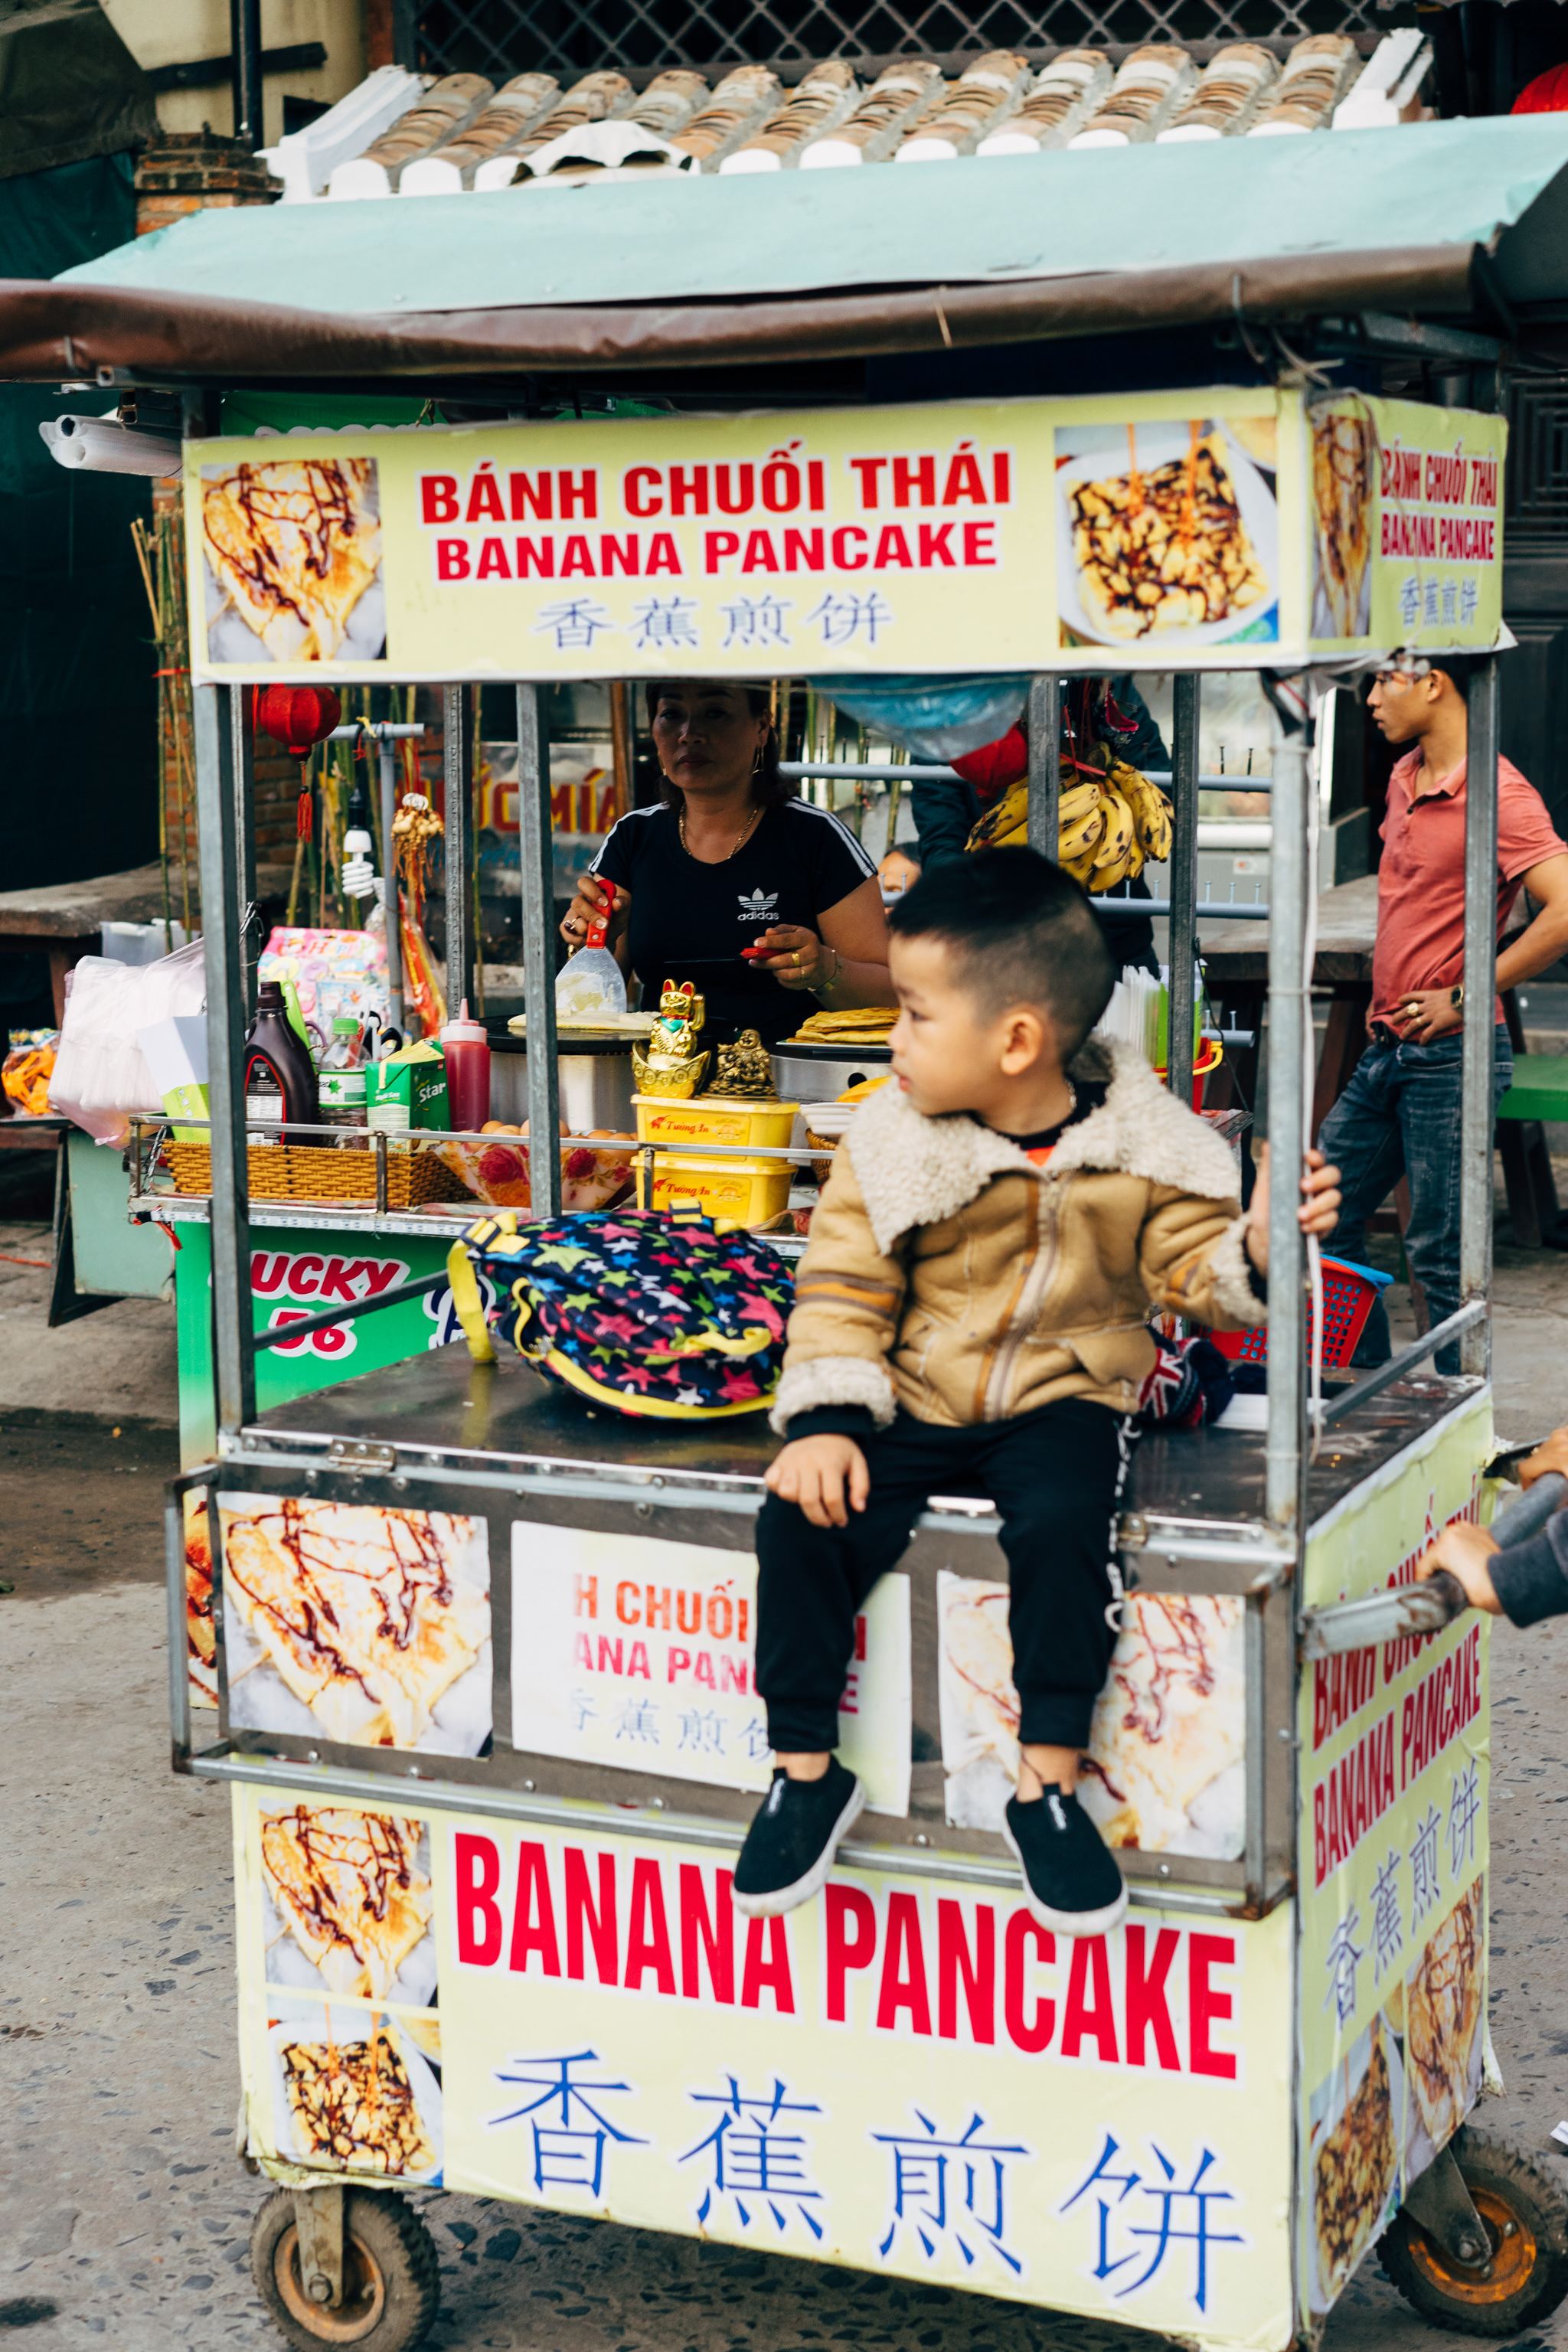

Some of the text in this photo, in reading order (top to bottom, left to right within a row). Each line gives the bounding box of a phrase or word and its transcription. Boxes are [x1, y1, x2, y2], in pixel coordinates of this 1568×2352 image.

[420, 441, 1010, 524] BÁNH CHUỐI THÁI
[437, 521, 996, 581] BANANA PANCAKE
[1381, 513, 1494, 560] BANANA PANCAKE
[536, 593, 892, 648] 香蕉煎饼
[737, 911, 779, 920] adidas
[419, 1082, 446, 1102] Star
[251, 1253, 400, 1302] UCKY
[616, 1578, 748, 1643] CHUỐI
[1314, 1708, 1395, 1888] BANANA
[1401, 1622, 1481, 1792] PANCAKE
[454, 1832, 1236, 2079] BANANA PANCAKE
[488, 2049, 1246, 2314] 香蕉煎饼
